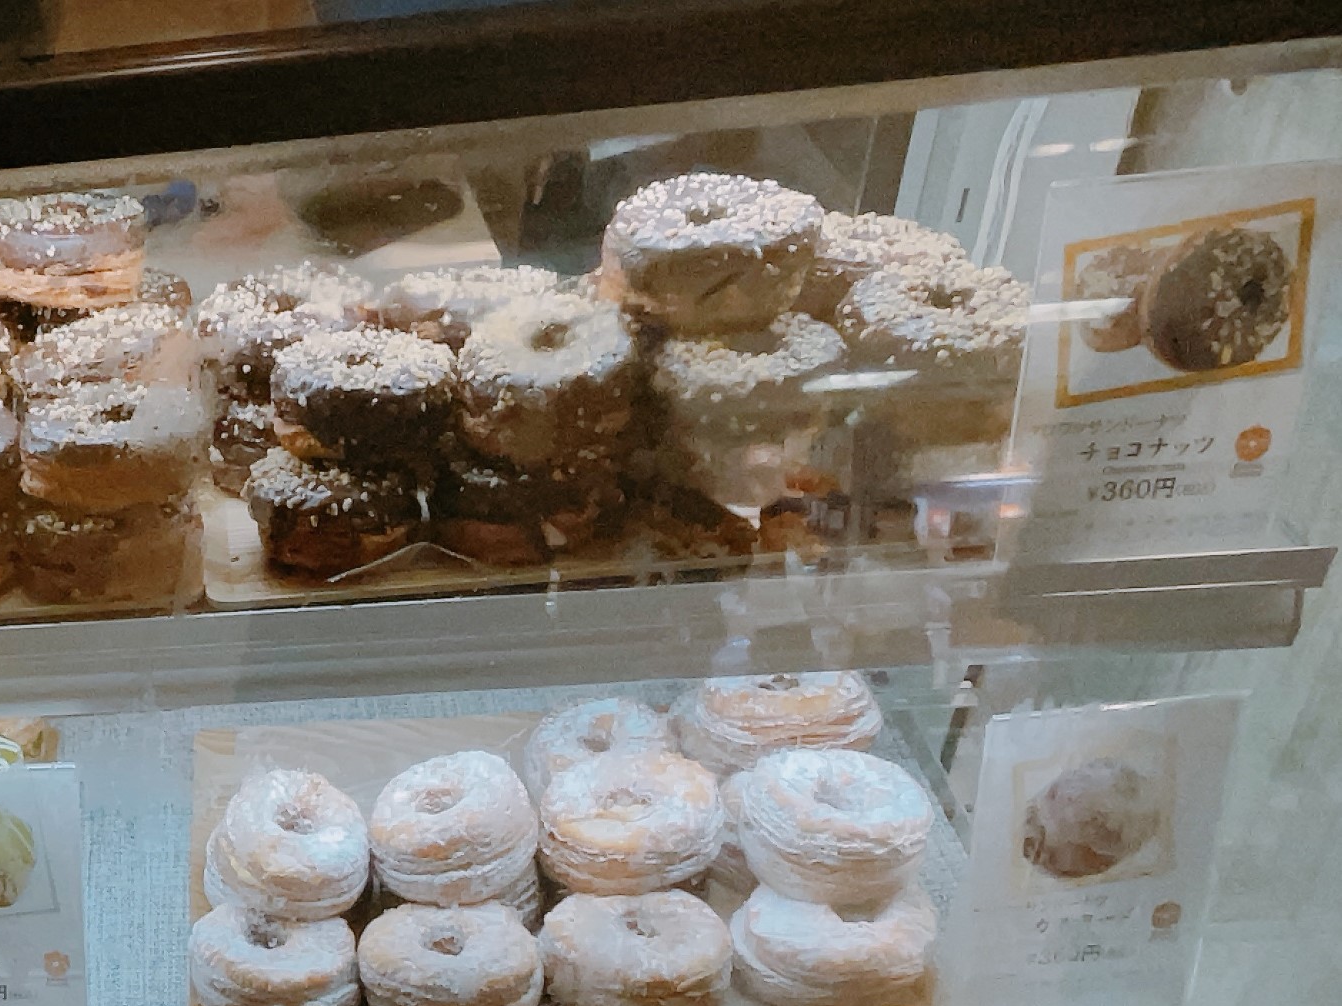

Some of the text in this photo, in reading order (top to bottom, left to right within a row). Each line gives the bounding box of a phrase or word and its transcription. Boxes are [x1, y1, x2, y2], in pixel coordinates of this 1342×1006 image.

[1077, 436, 1215, 462] チョコナッツ
